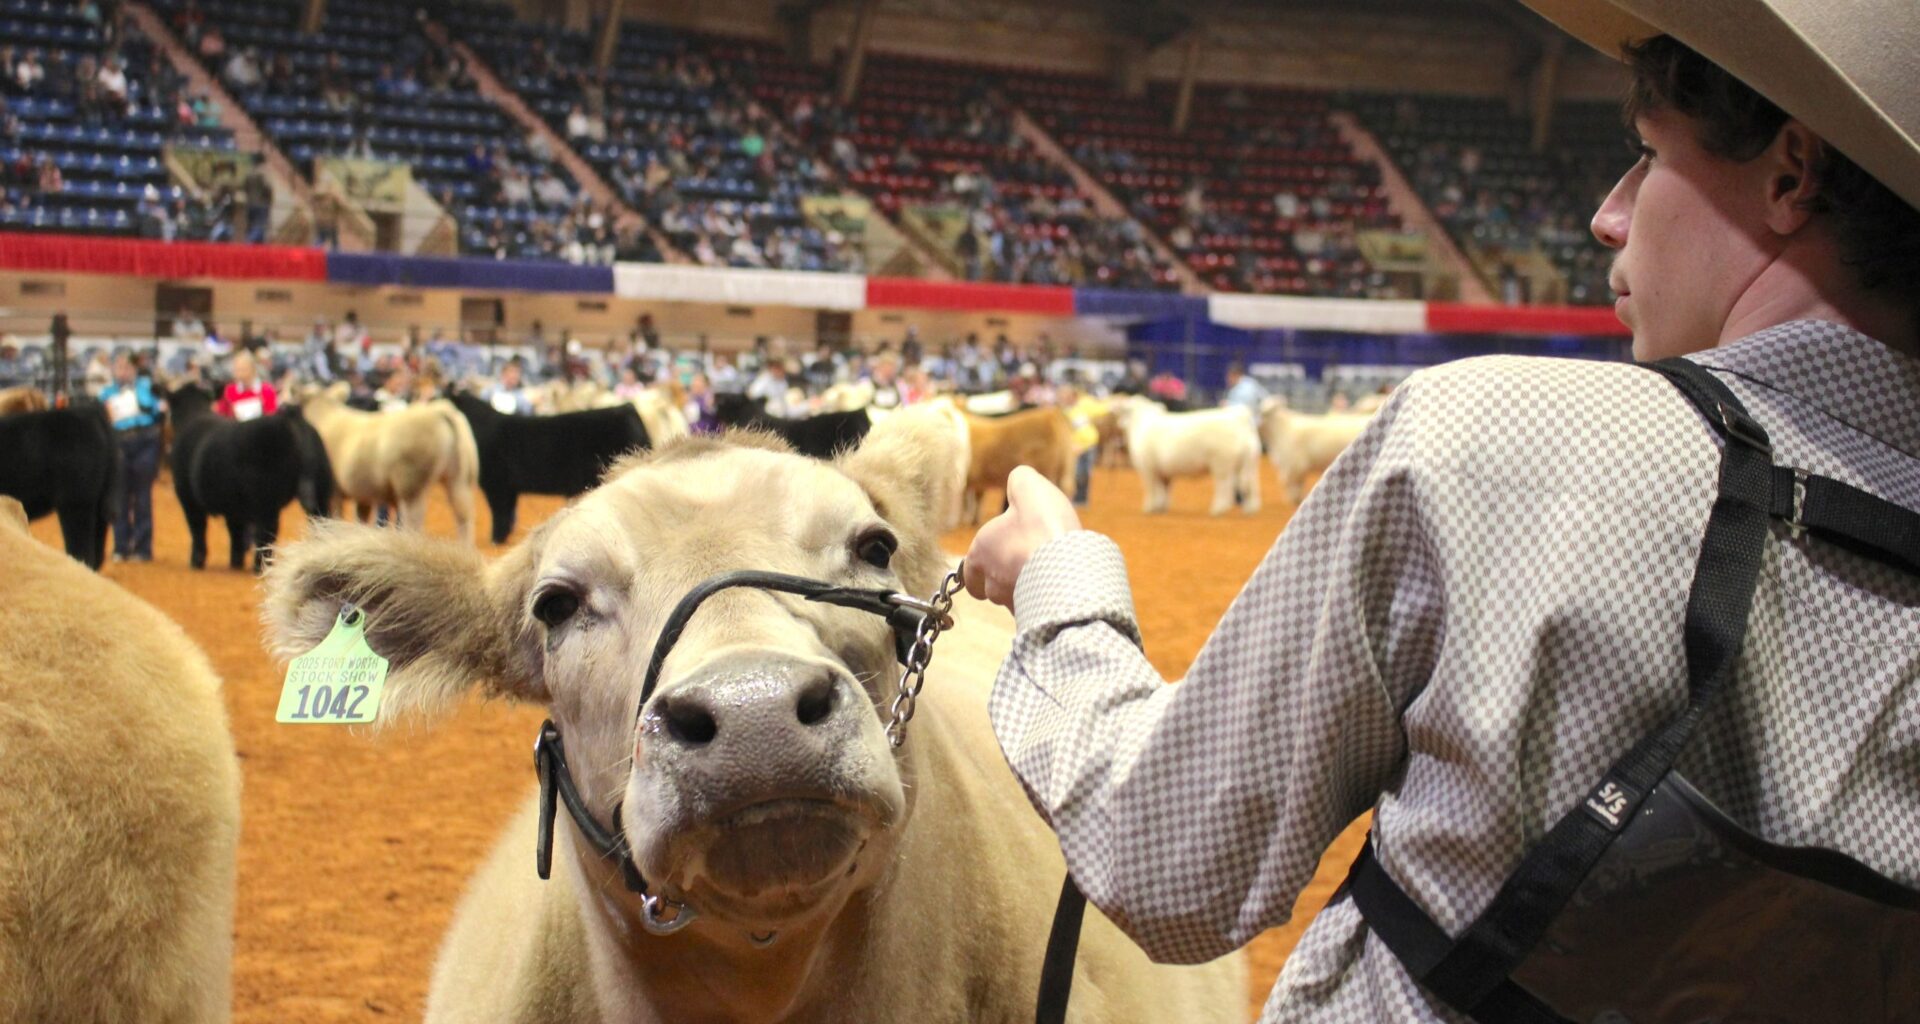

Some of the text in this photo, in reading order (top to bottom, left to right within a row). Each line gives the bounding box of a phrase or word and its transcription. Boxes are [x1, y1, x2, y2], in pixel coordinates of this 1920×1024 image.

[297, 656, 378, 669] 2025 FORT WORTH
[290, 671, 378, 683] STOCK SHOW
[291, 685, 370, 719] 1042
